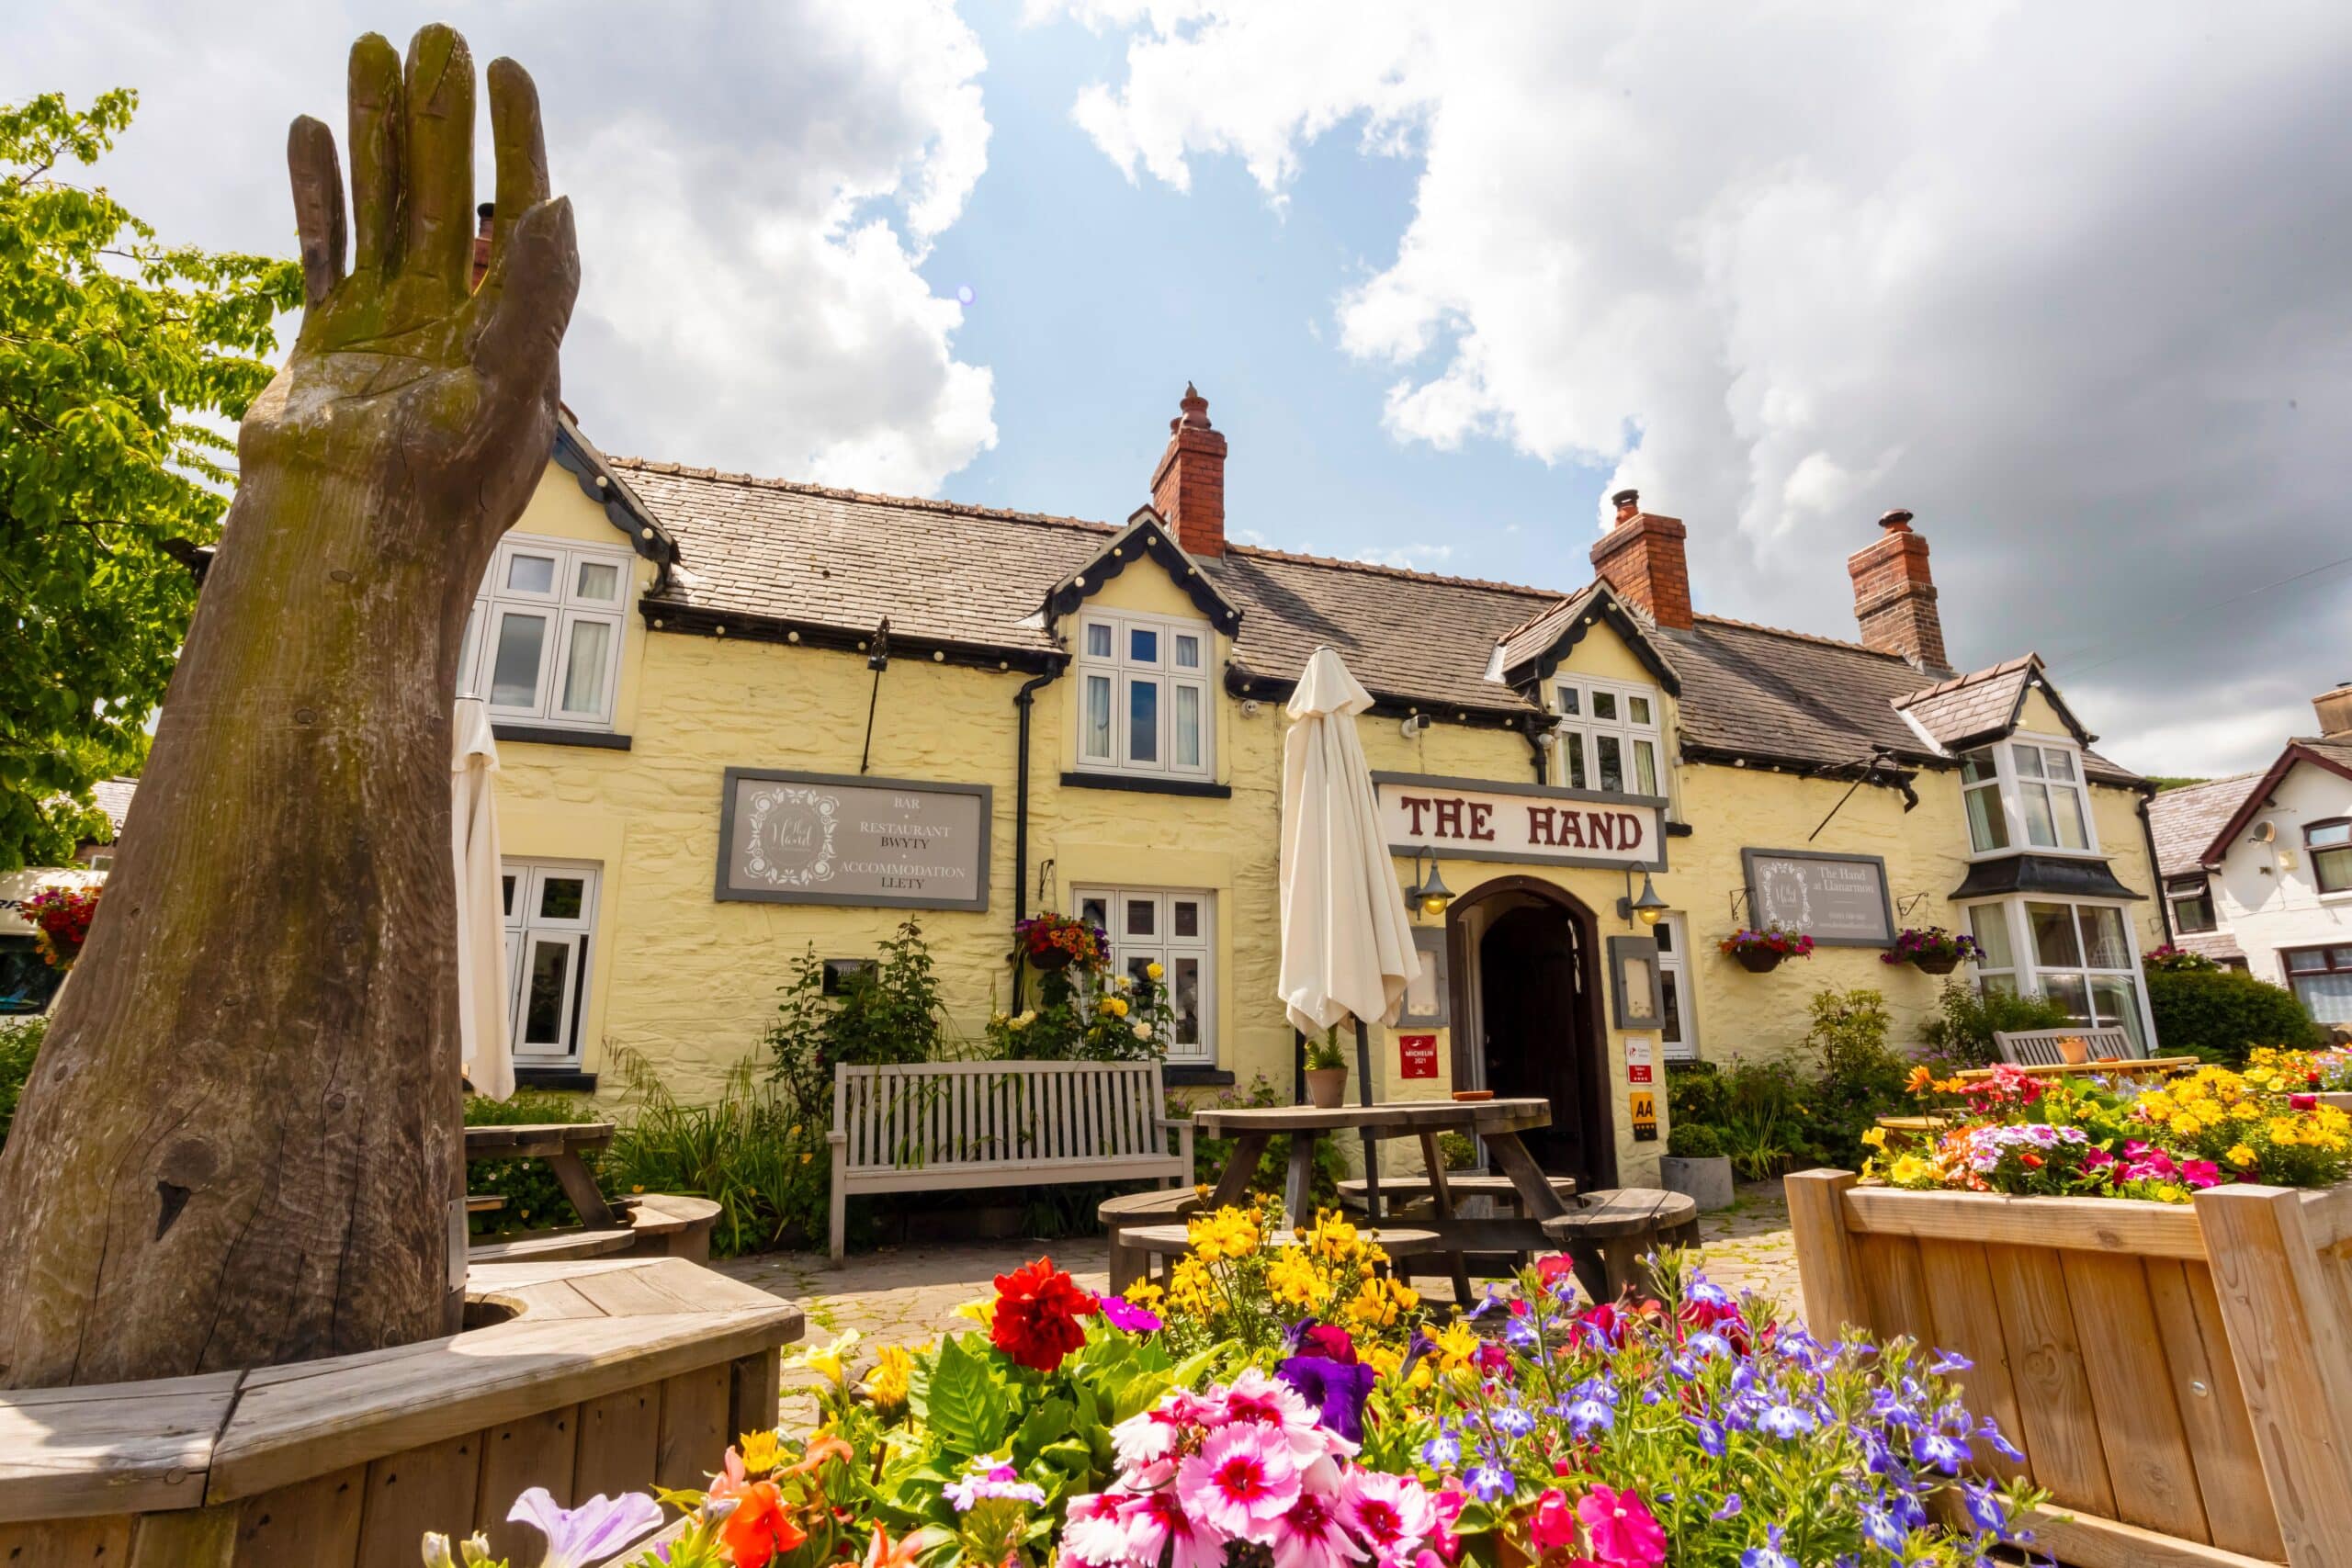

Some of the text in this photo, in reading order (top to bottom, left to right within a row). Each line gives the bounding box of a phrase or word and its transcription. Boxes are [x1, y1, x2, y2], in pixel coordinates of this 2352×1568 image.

[894, 795, 921, 809] BAR
[860, 821, 953, 838] RESTAURANT
[1401, 795, 1643, 851] THE HAND
[881, 836, 930, 850] BWYTY
[841, 862, 965, 878] ACCOMMODATION
[1816, 866, 1866, 881] The Hand
[881, 877, 925, 889] LLETY
[1824, 879, 1874, 894] Llanarmon
[1635, 1100, 1654, 1118] AA
